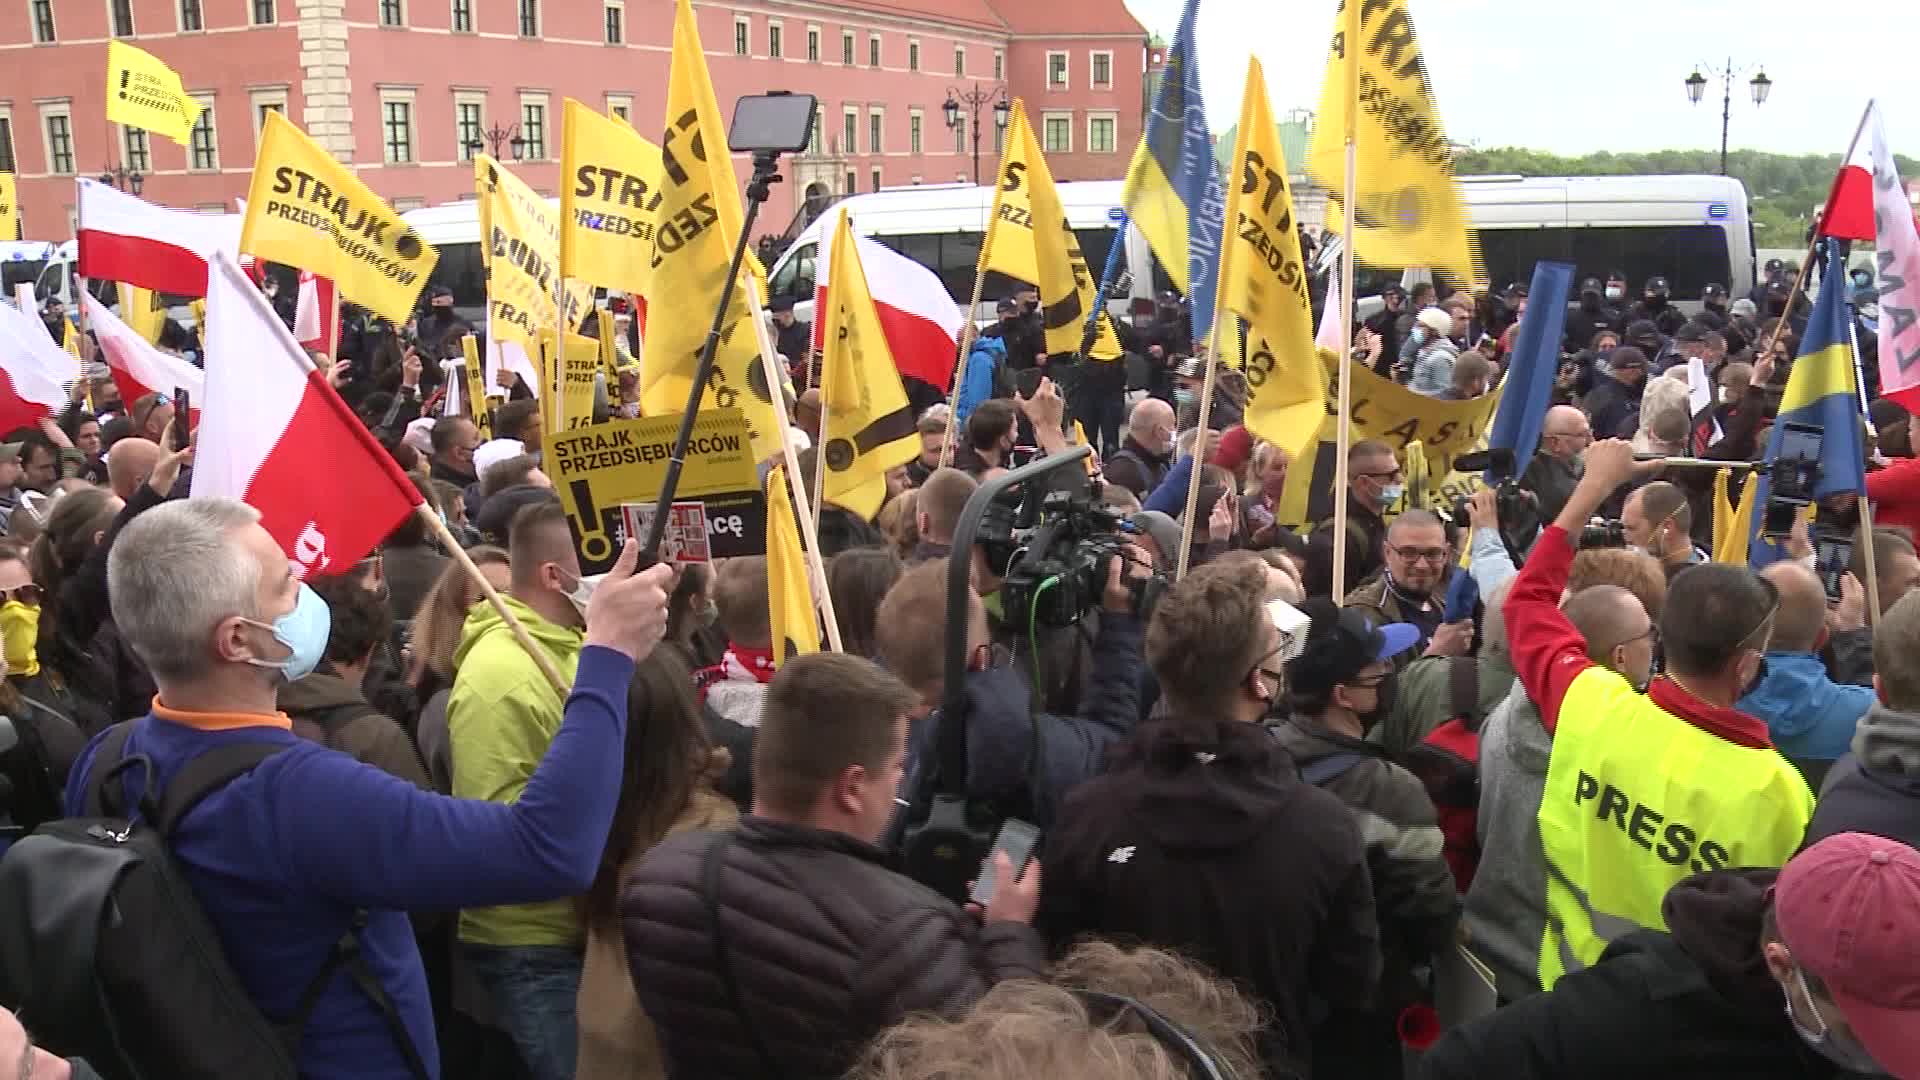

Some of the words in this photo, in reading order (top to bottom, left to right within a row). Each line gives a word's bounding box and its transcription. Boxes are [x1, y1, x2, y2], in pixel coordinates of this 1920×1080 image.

[272, 166, 390, 245] STRAJK
[554, 429, 633, 458] STRAJK
[1575, 768, 1729, 874] PRESS
